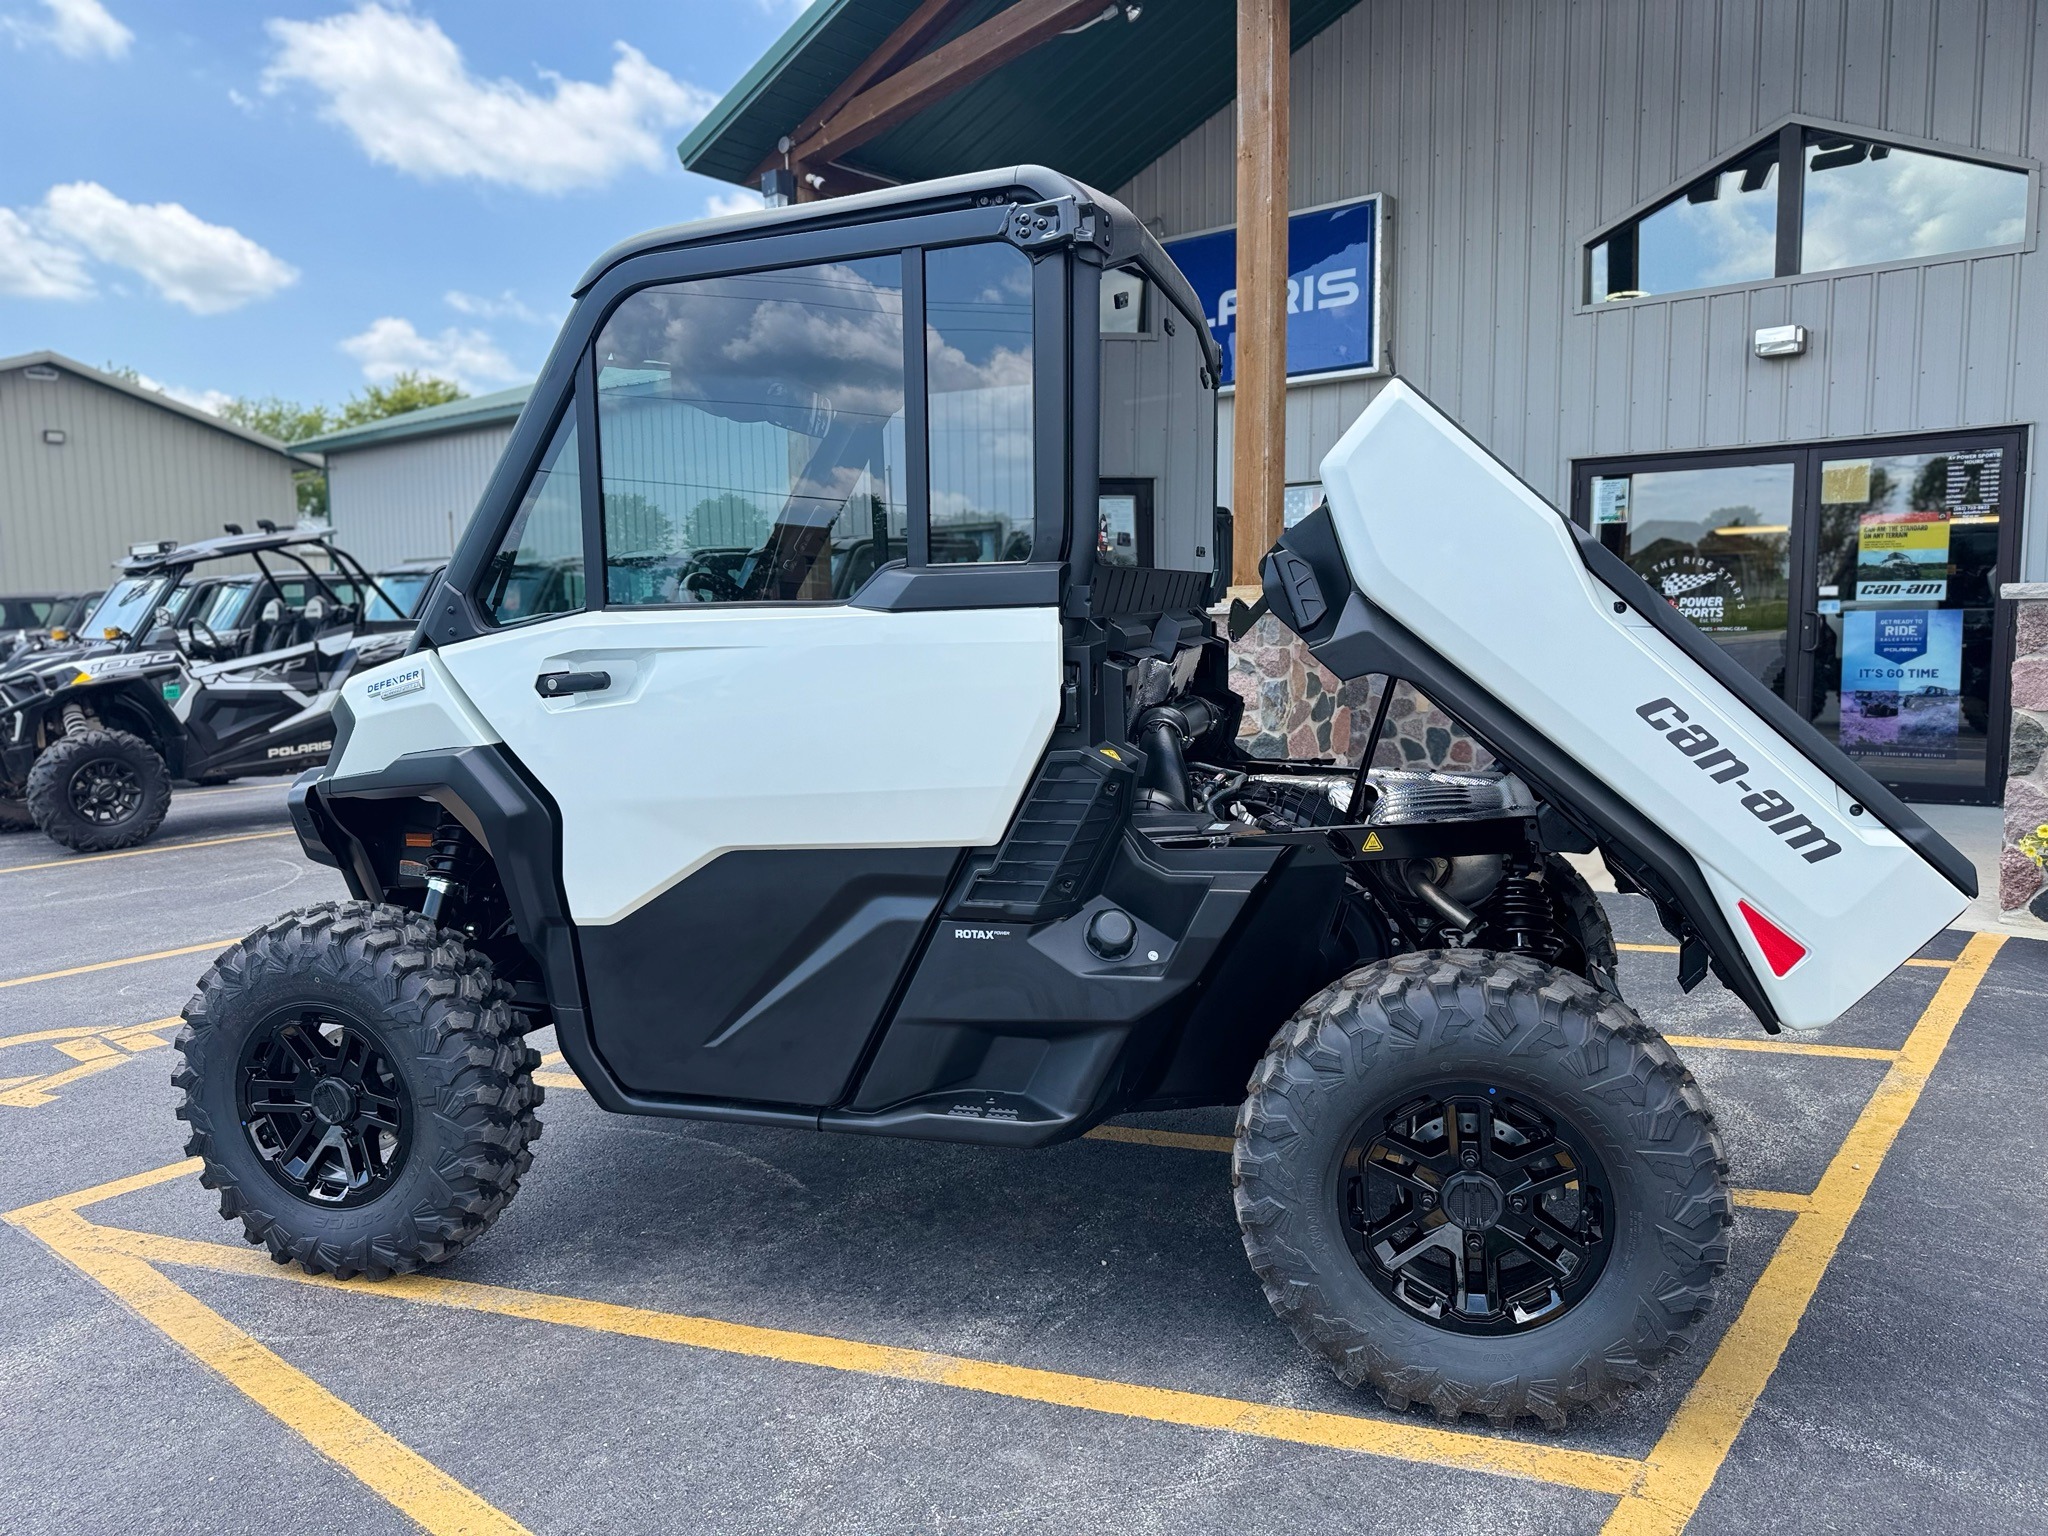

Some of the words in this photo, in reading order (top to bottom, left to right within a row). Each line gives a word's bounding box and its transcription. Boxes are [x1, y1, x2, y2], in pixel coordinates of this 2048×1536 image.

[1652, 558, 1676, 573] THE
[1683, 556, 1714, 569] RIDE
[1717, 567, 1746, 610] STARTS
[1860, 583, 1943, 595] can-am
[1679, 596, 1724, 608] POWER
[1885, 625, 1918, 637] RIDE
[90, 652, 177, 675] 1000
[257, 657, 307, 679] XP
[1859, 668, 1884, 678] IT'S
[1886, 669, 1904, 678] GO
[1908, 668, 1940, 678] TIME
[367, 670, 420, 693] DEFENDER
[267, 740, 333, 759] POLARIS
[1635, 697, 1842, 864] can-am
[955, 929, 995, 940] ROTAX
